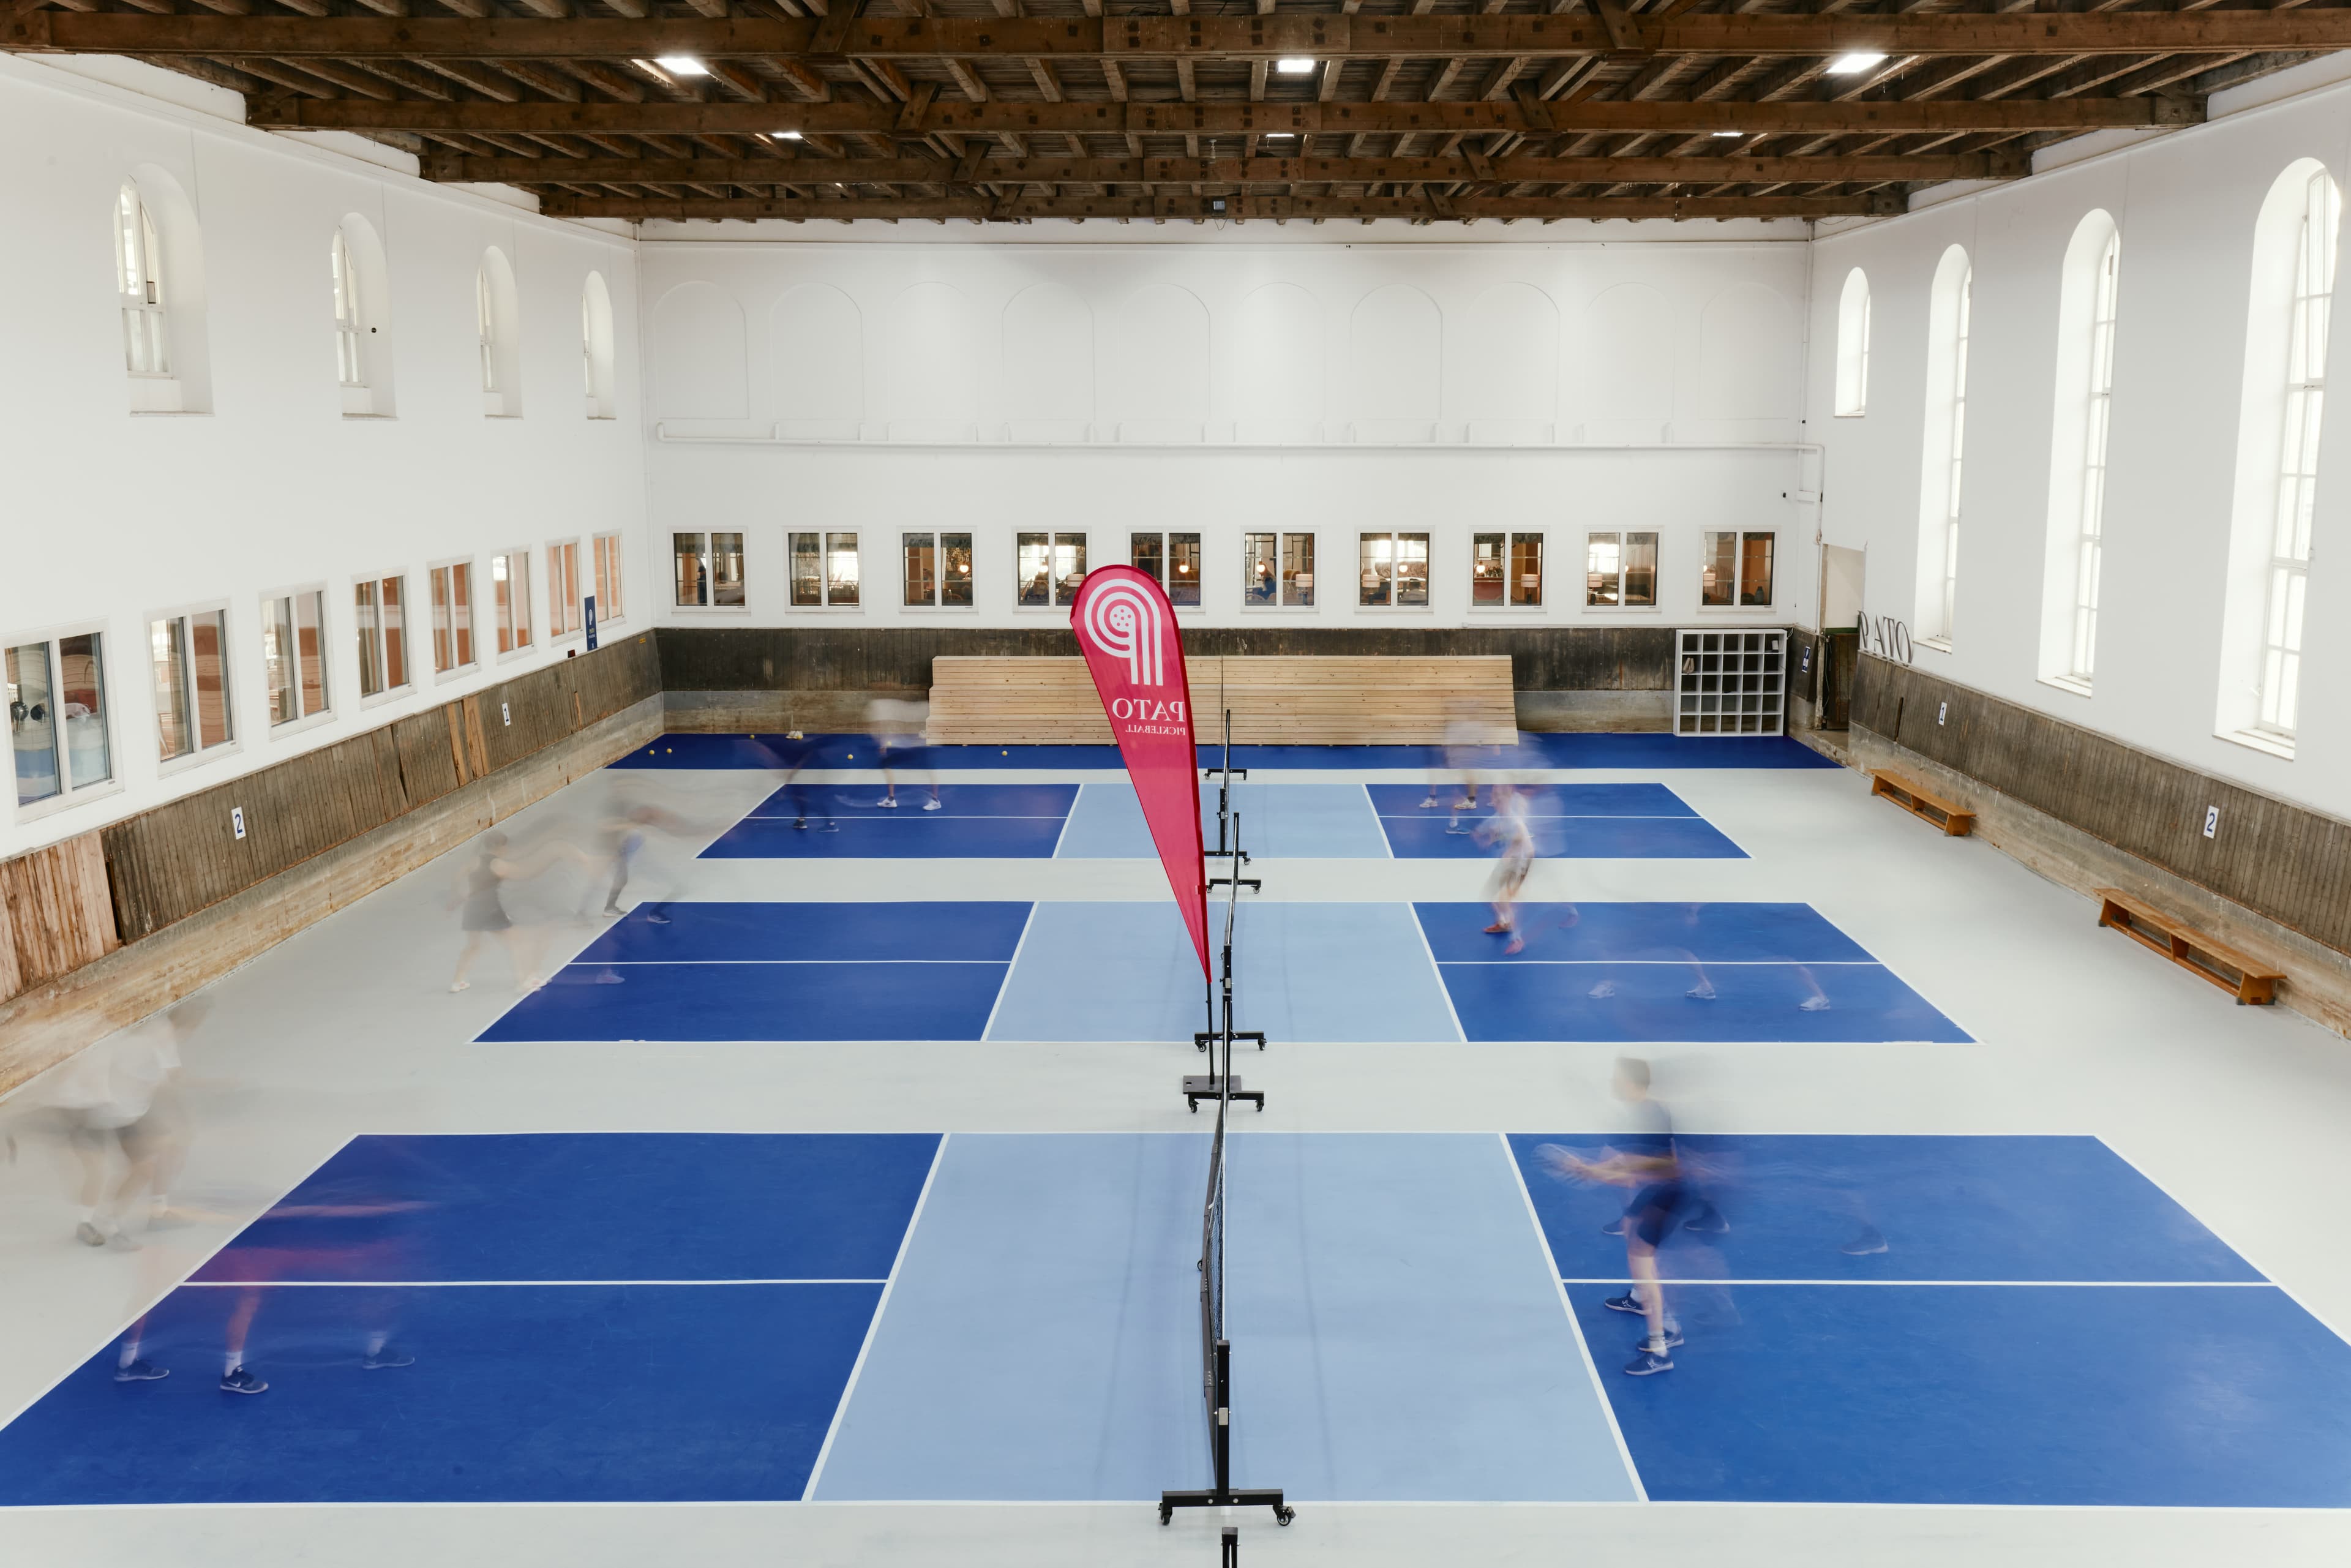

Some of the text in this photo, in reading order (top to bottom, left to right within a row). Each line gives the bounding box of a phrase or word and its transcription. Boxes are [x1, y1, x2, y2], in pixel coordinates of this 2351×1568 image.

[1858, 610, 1911, 667] PATO
[504, 708, 509, 722] 1
[1940, 707, 1944, 721] 1
[234, 813, 243, 834] 2
[2207, 812, 2215, 833] 2
